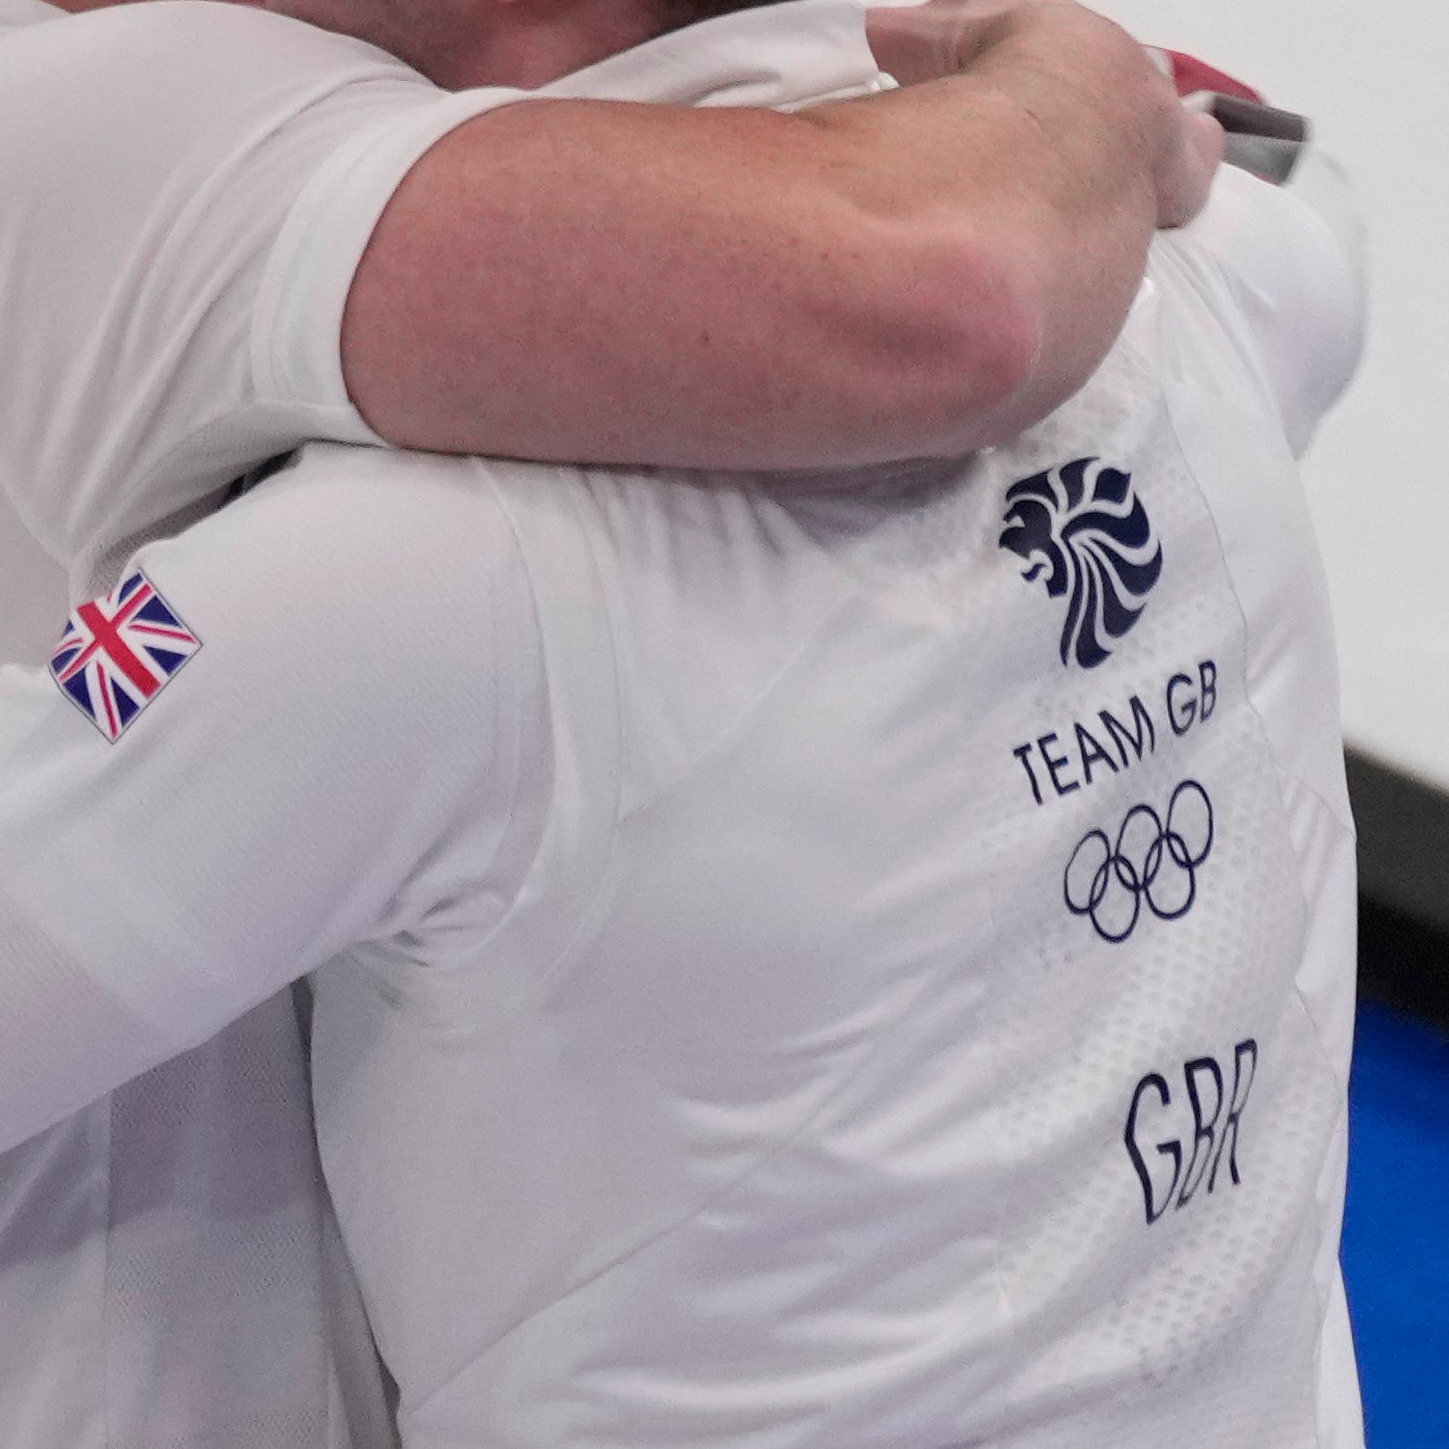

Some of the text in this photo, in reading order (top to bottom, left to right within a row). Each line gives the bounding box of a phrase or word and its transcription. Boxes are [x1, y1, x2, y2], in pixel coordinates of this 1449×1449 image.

[1013, 660, 1217, 806] TEAM GB
[1125, 1038, 1257, 1225] GBR
